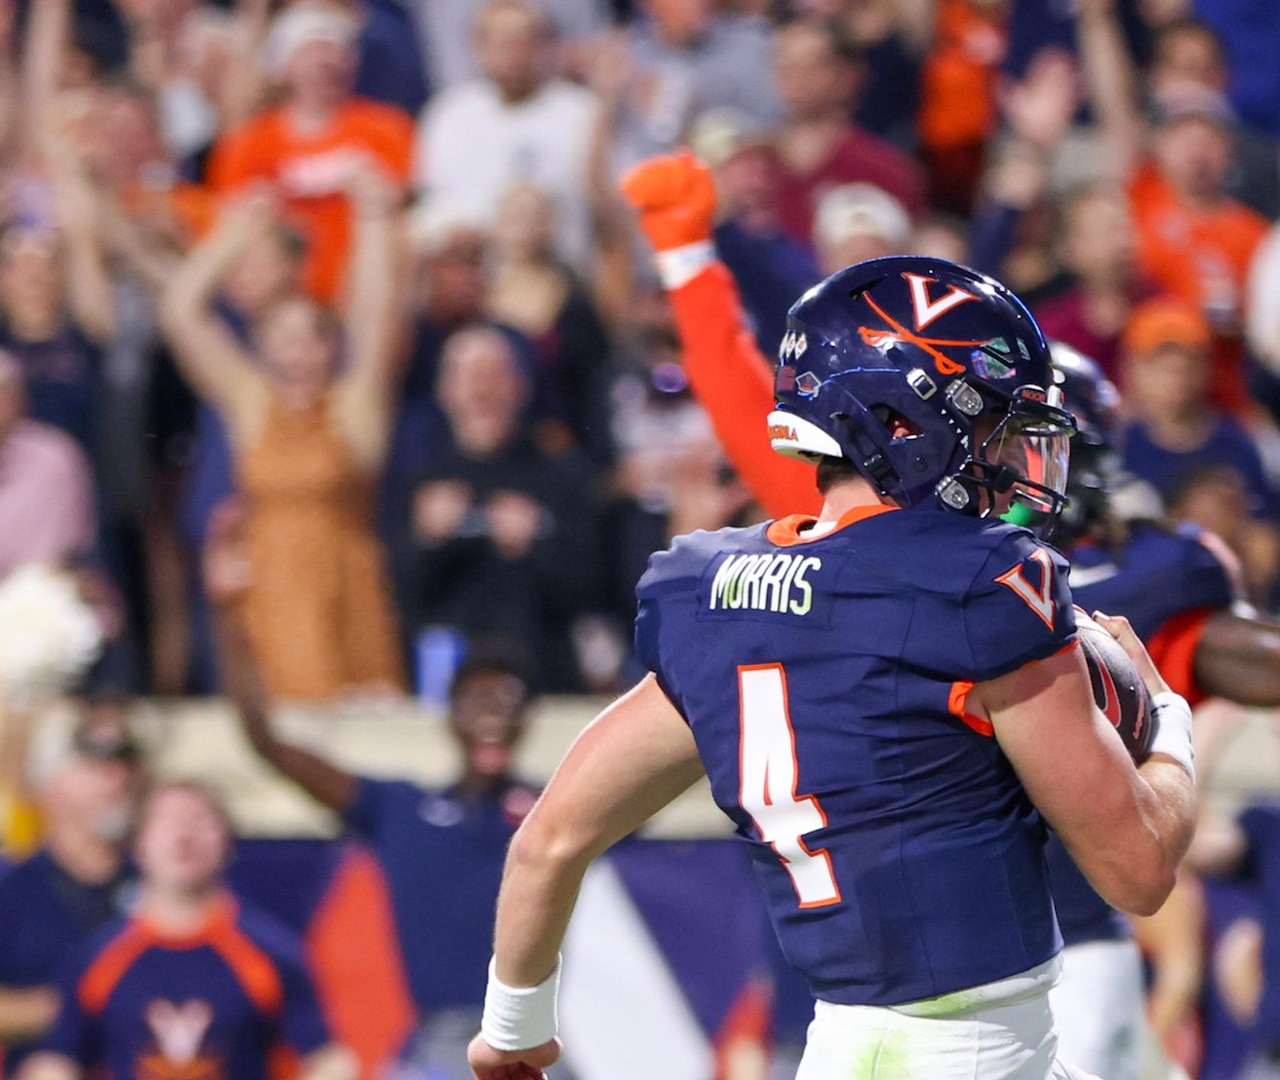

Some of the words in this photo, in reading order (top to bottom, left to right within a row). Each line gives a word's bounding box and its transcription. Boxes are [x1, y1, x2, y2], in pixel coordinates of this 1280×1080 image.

[902, 271, 983, 332] V
[708, 553, 822, 617] MORRIS
[994, 546, 1056, 632] V
[736, 662, 842, 908] 4
